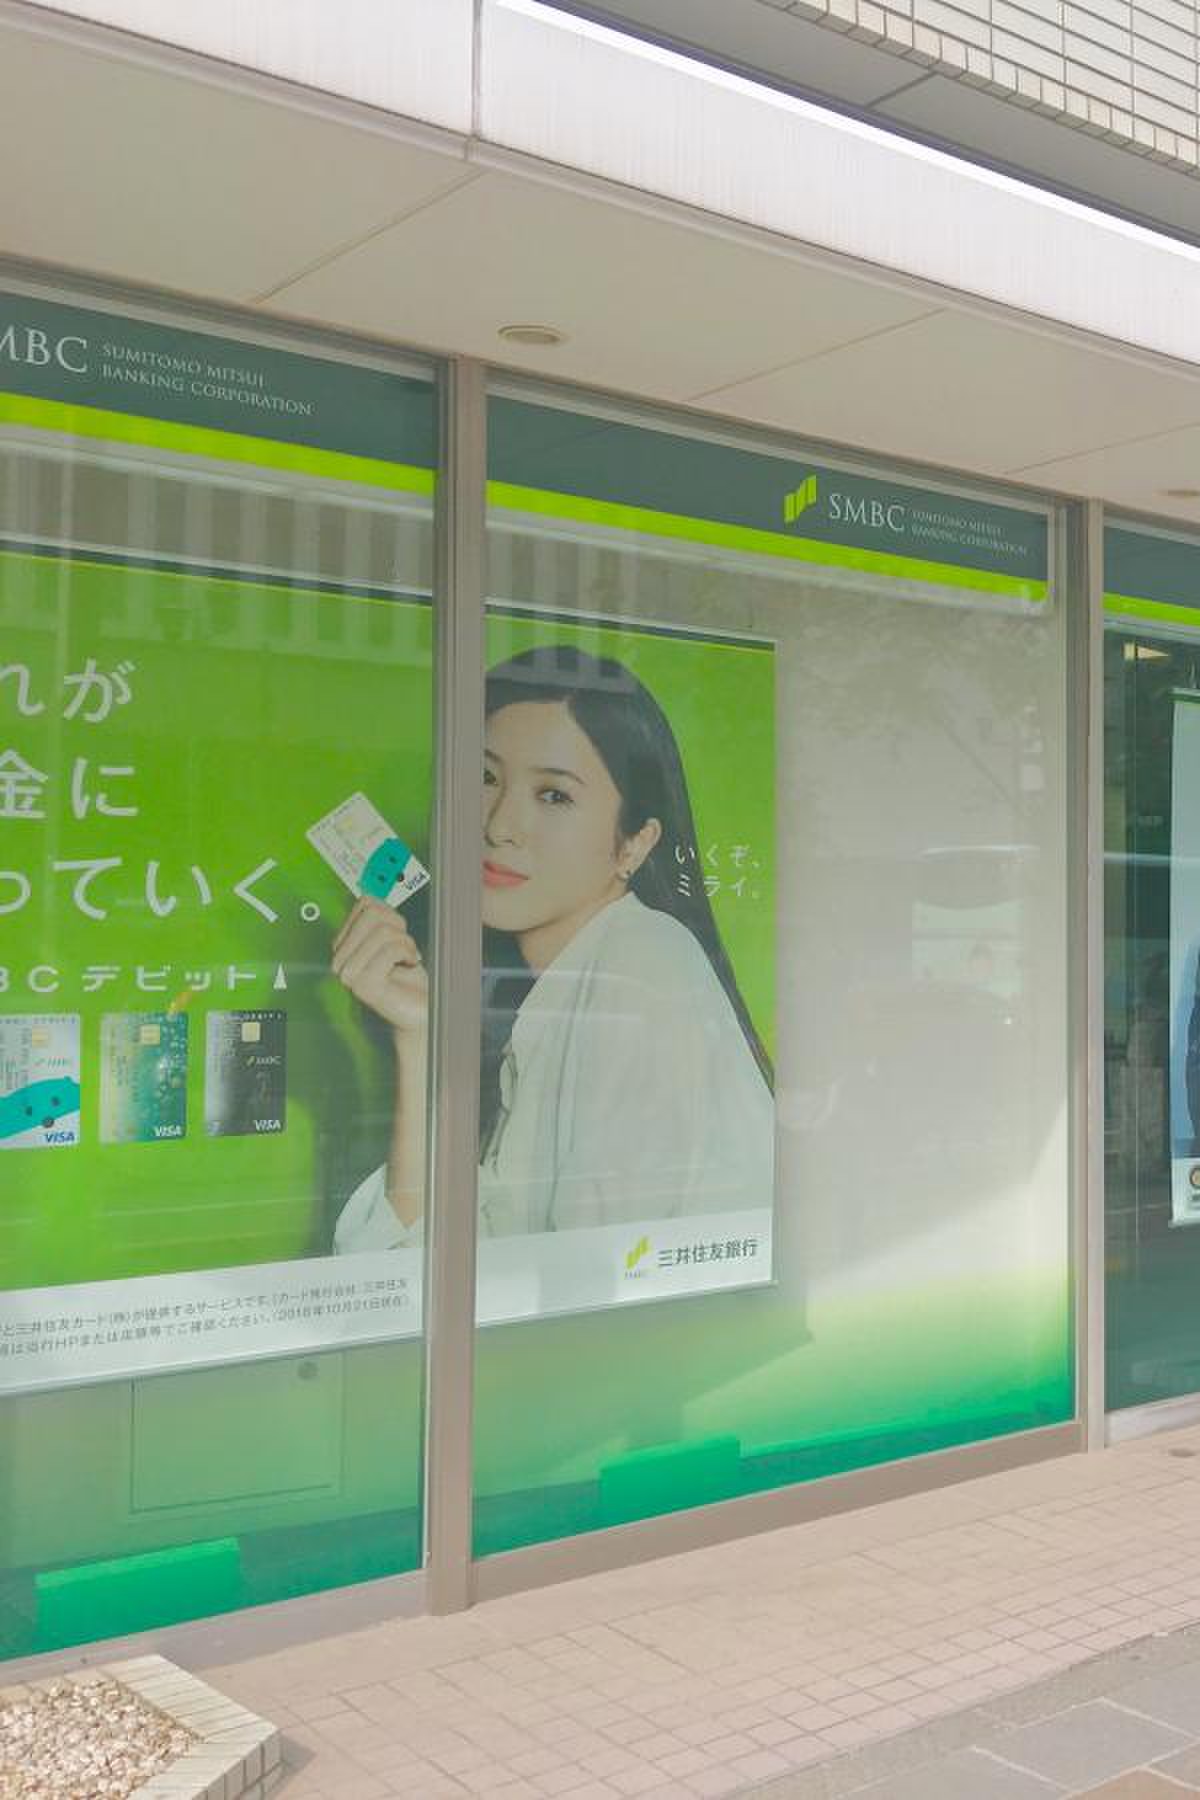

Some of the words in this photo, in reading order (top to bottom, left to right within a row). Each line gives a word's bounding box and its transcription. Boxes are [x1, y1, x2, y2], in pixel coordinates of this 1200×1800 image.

[103, 344, 202, 374] SUMITOMO
[207, 366, 264, 388] MITSUI
[103, 364, 185, 392] BANKING
[191, 382, 312, 416] CORPORATION
[829, 493, 905, 532] SMBC
[44, 1130, 76, 1144] VISA
[154, 1125, 183, 1138] VISA
[254, 1119, 282, 1132] VISA
[658, 1239, 758, 1267] 三井住友銀行
